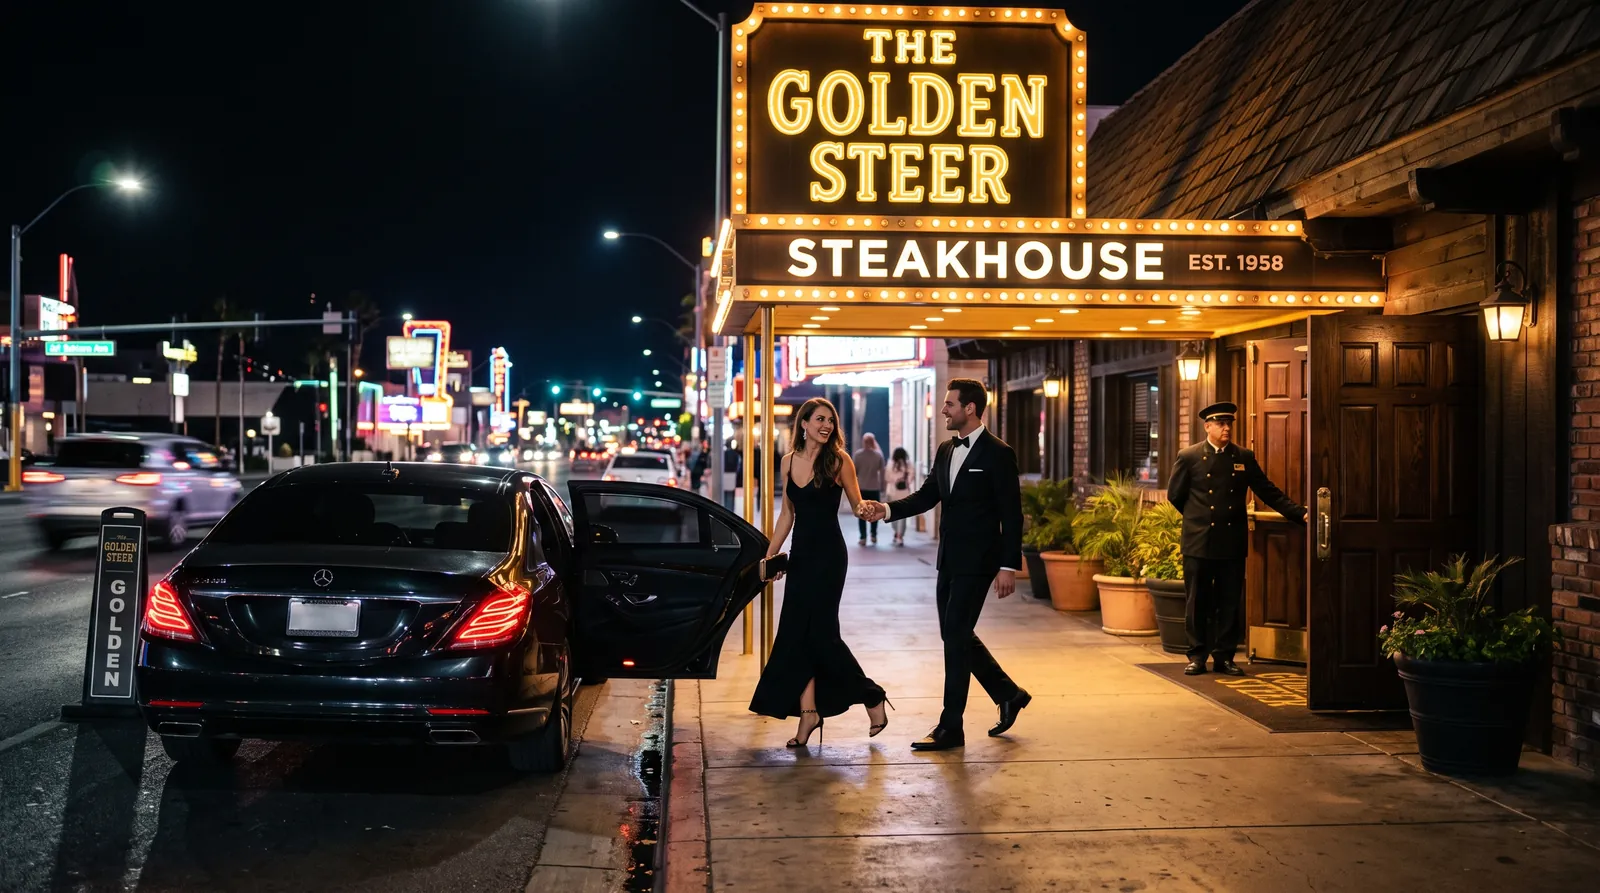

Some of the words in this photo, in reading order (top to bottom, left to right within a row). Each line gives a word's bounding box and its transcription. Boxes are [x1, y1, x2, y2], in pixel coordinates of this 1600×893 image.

[863, 29, 957, 64] THE
[768, 69, 1047, 138] GOLDEN
[809, 141, 1011, 204] STEER
[787, 239, 1164, 281] STEAKHOUSE
[1188, 254, 1231, 270] EST.
[1236, 254, 1284, 271] 1958
[104, 541, 137, 552] GOLDEN
[106, 552, 133, 563] STEER
[104, 579, 126, 687] GOLDEN
